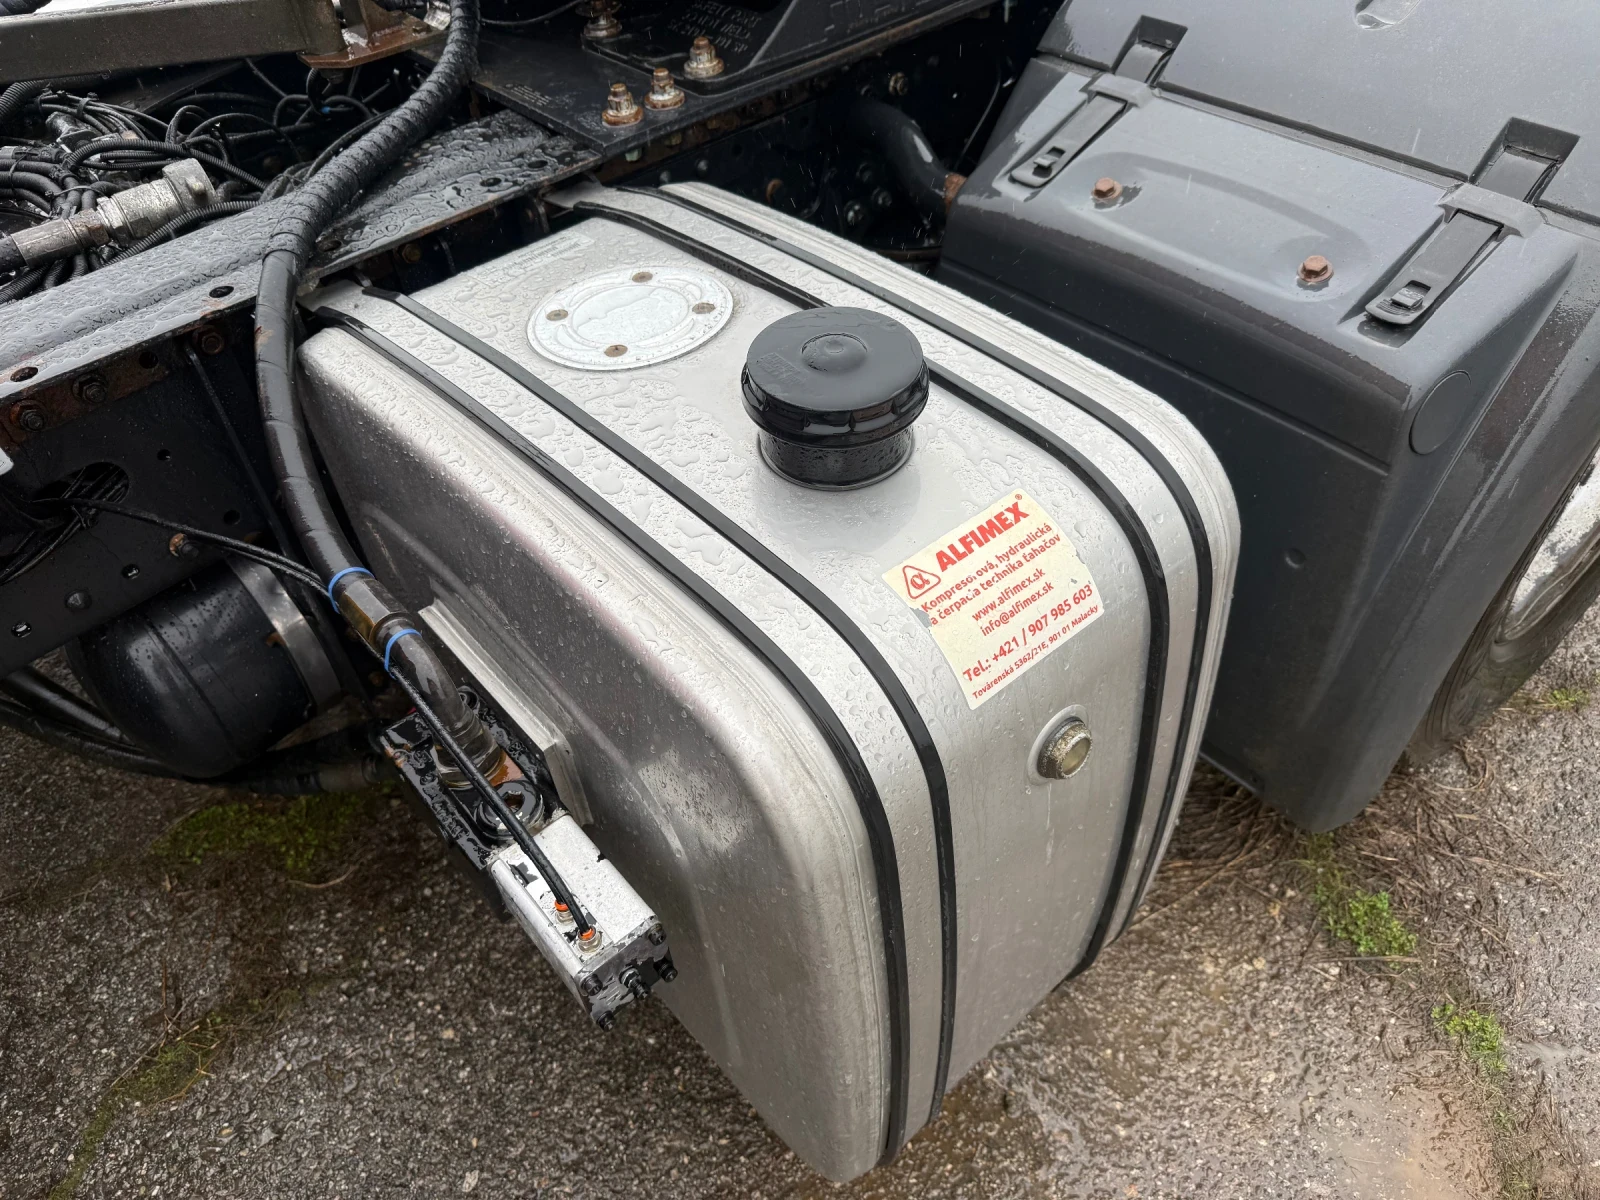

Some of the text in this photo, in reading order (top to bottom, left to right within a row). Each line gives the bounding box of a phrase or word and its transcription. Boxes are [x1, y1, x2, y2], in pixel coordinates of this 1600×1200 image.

[936, 501, 1029, 572] ALFIMEX
[995, 522, 1052, 563] hydraulická
[930, 617, 938, 625] a
[979, 560, 1024, 590] technika
[972, 568, 1046, 622] www.alfimex.sk
[980, 581, 1054, 636] info@alfimex.sk
[962, 584, 1093, 682] Tel.: +421 / 907 985 603
[972, 605, 1098, 699] Továrenská 5362/21E, 901 01 Malacky
